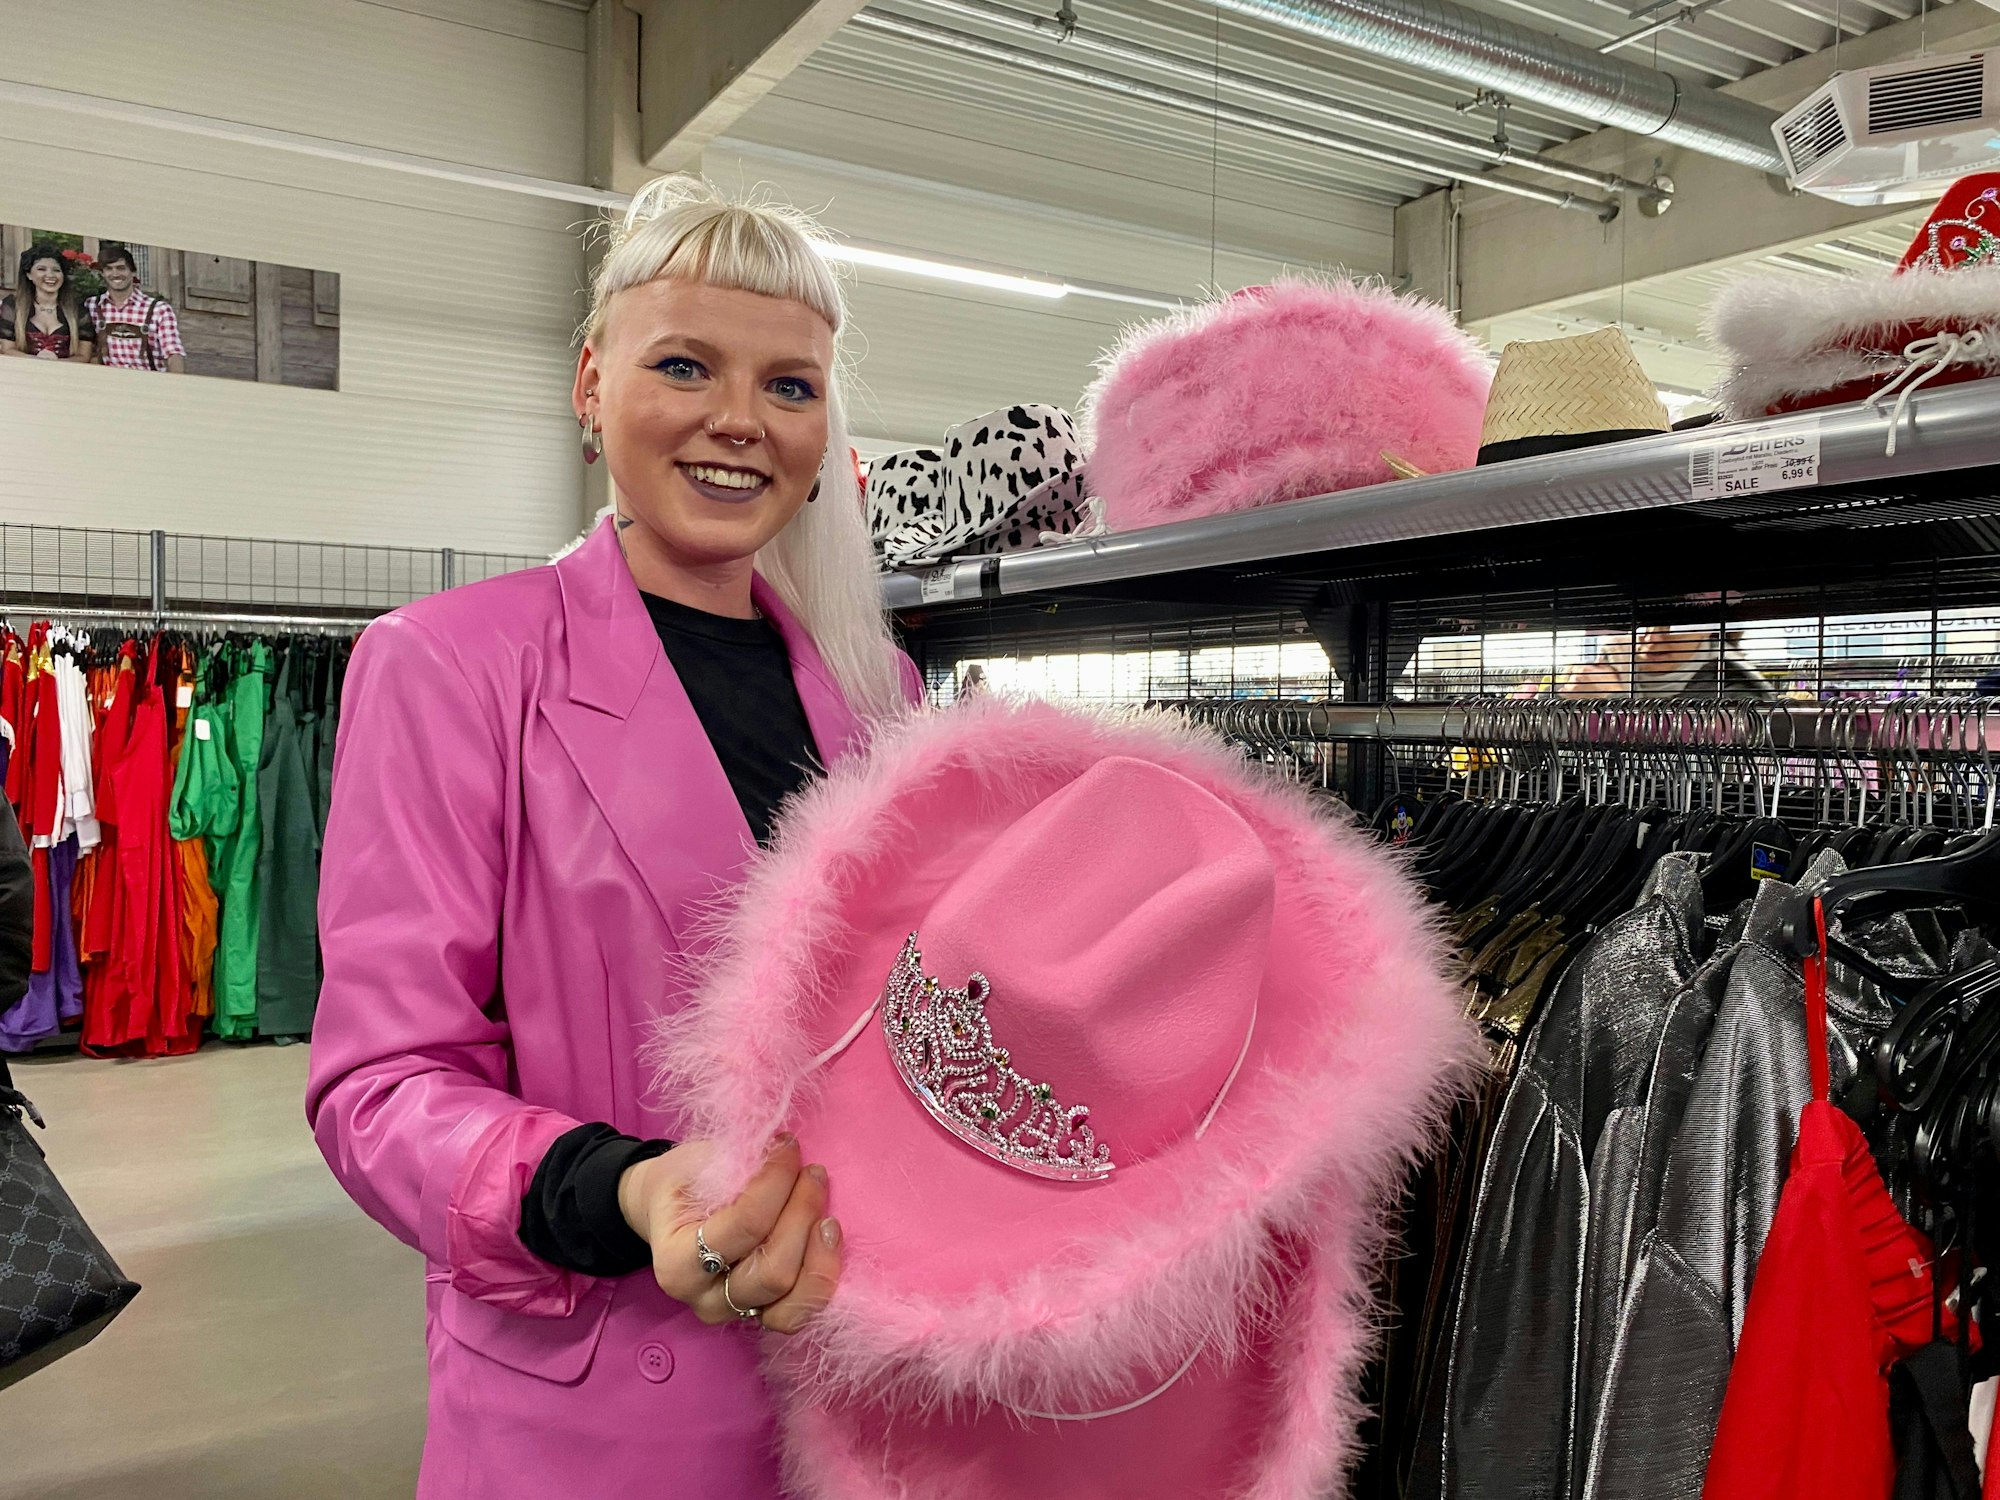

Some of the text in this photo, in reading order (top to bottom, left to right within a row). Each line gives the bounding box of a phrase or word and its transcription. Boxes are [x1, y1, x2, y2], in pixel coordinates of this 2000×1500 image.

[1722, 434, 1805, 456] DEITERS
[1806, 466, 1813, 476] €
[1725, 477, 1759, 492] SALE
